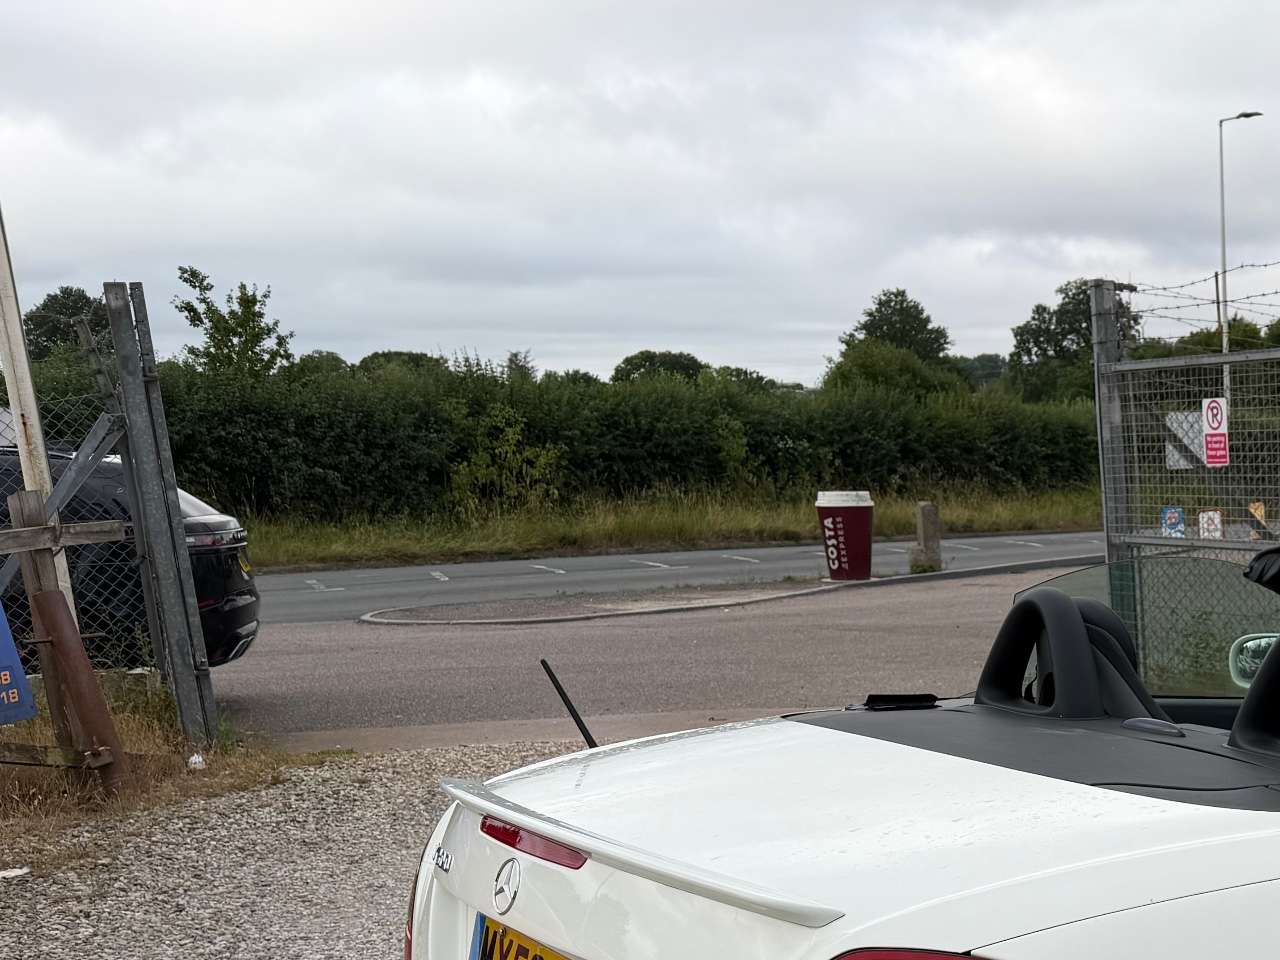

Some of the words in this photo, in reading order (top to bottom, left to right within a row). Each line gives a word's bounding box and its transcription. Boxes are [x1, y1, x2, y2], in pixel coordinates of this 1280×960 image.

[823, 516, 839, 570] COSTA
[835, 516, 848, 564] EXPRESS
[0, 671, 10, 685] 8
[1, 688, 18, 704] 18
